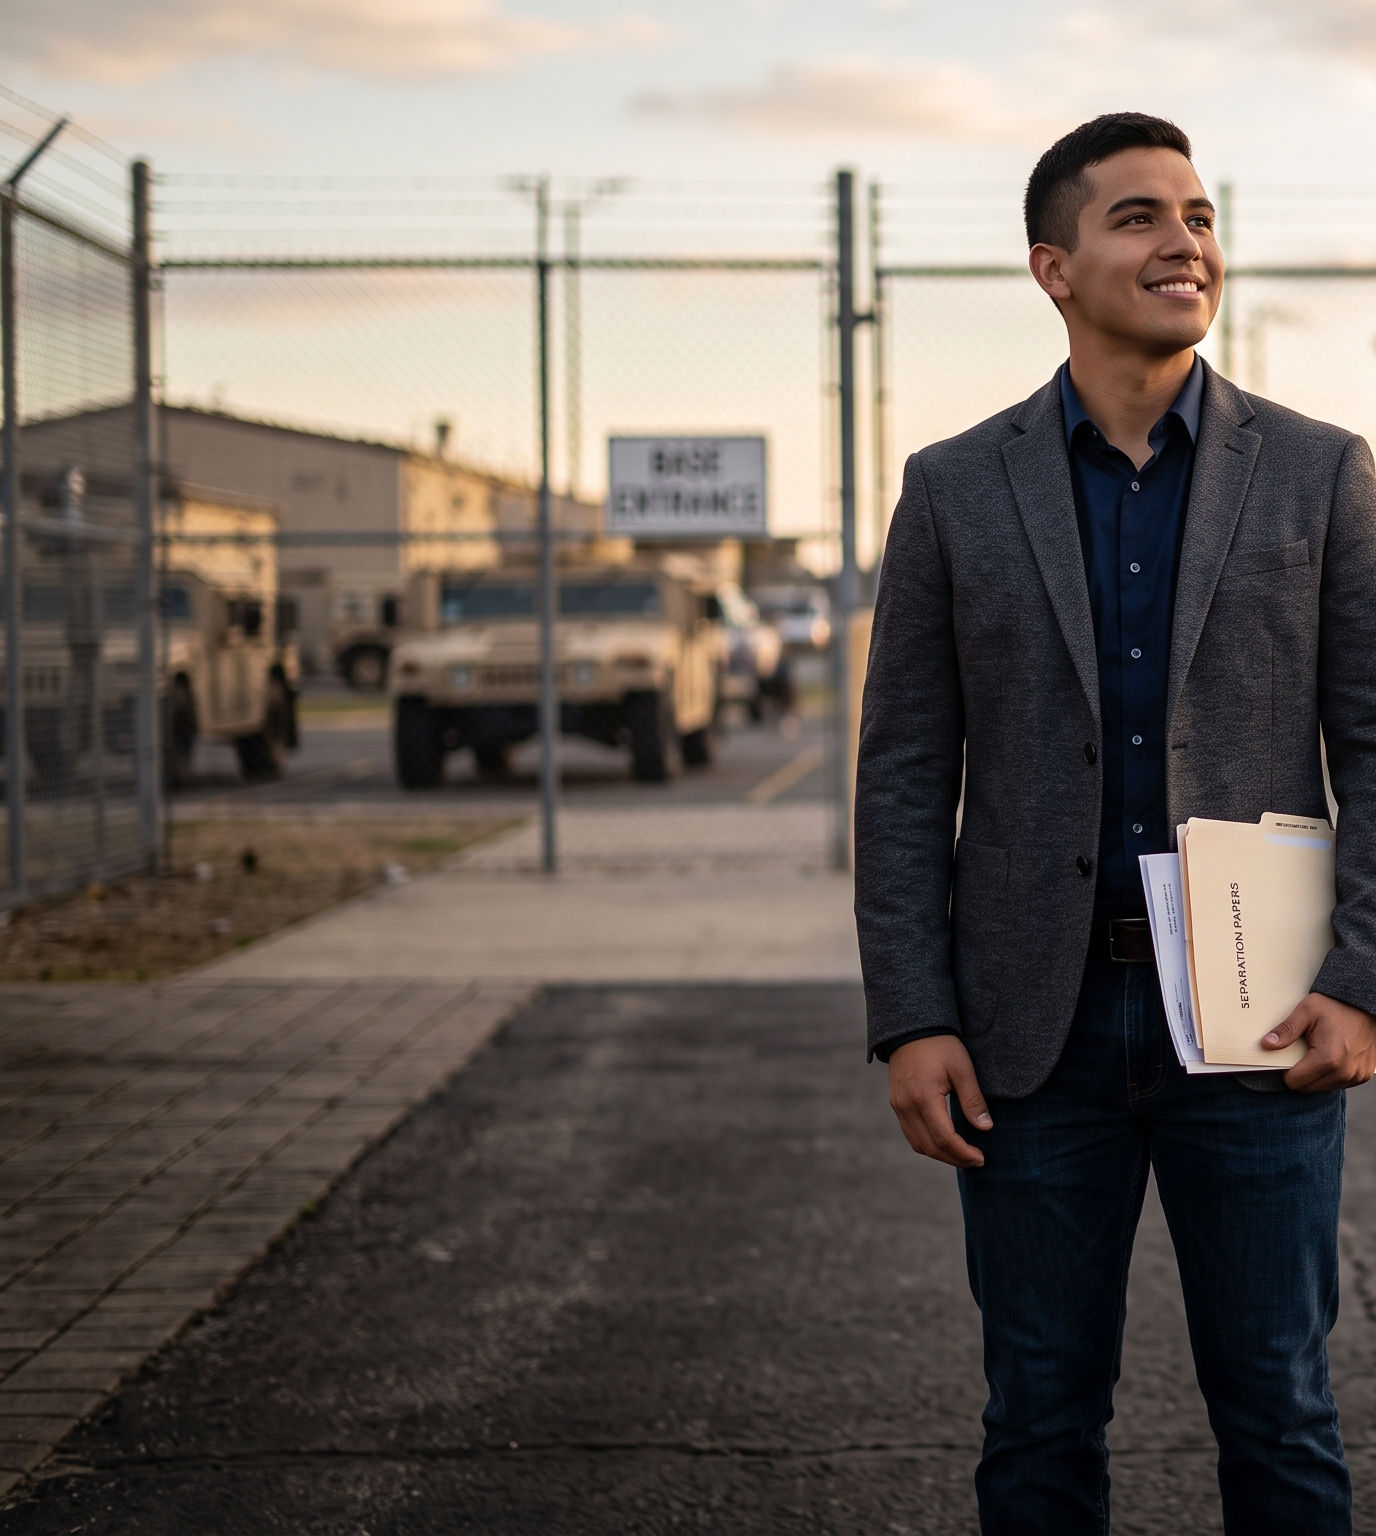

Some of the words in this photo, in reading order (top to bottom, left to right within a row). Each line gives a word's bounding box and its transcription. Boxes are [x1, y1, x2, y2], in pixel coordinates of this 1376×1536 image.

[651, 446, 720, 477] BASE
[616, 485, 758, 517] ENTRANCE
[1230, 882, 1242, 928] PAPERS
[1235, 931, 1249, 1008] SEPARATION
